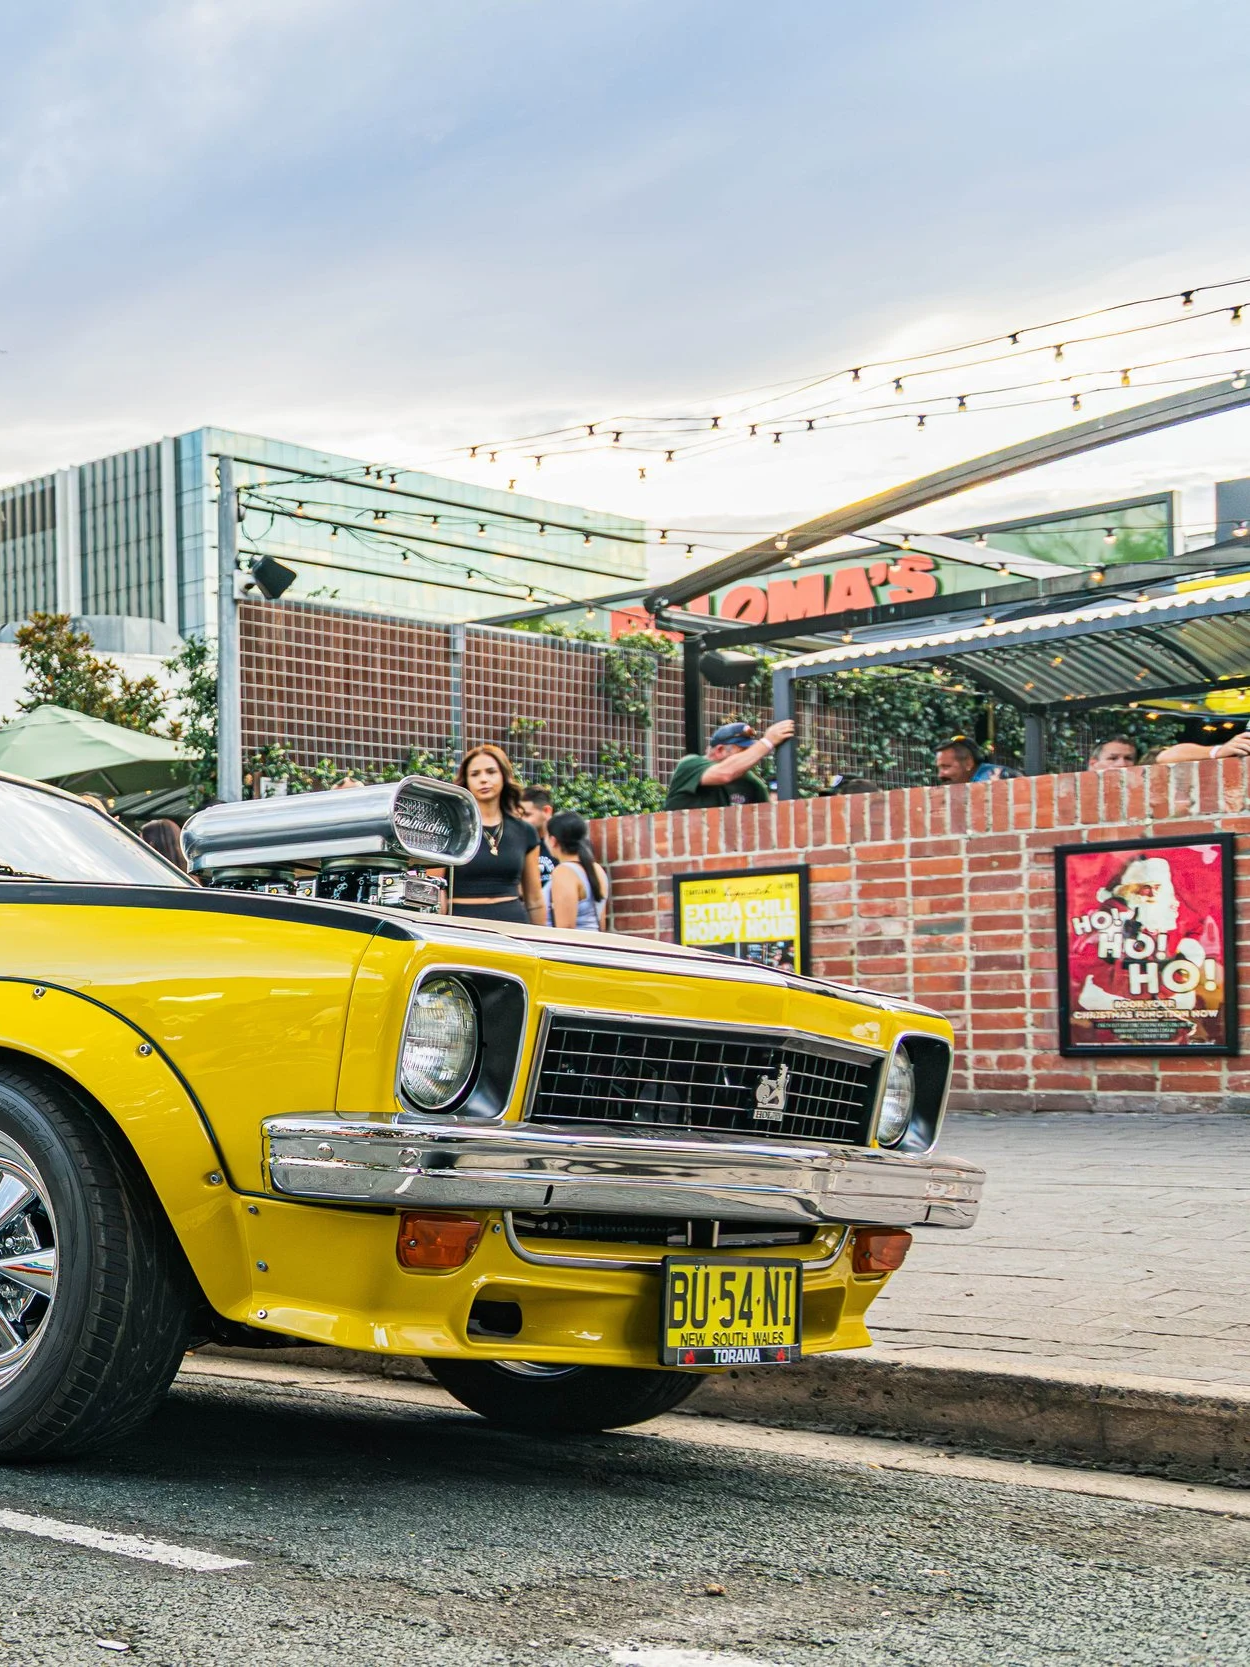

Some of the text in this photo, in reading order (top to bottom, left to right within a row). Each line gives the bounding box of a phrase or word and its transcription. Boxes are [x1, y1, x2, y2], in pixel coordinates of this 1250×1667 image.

[611, 554, 937, 642] POMA'S
[684, 898, 796, 921] EXTRA CHILL
[685, 917, 796, 941] HOPPY HOUR
[1072, 908, 1123, 935] HO!
[1098, 933, 1168, 961] HO!
[1128, 959, 1217, 995] HO!
[1073, 1010, 1219, 1019] CHRISTMAS FUNCTION NOW
[1114, 1000, 1176, 1009] BOOK YOUR
[680, 1331, 784, 1347] NEW SOUTH WALES
[713, 1349, 761, 1363] TORANA
